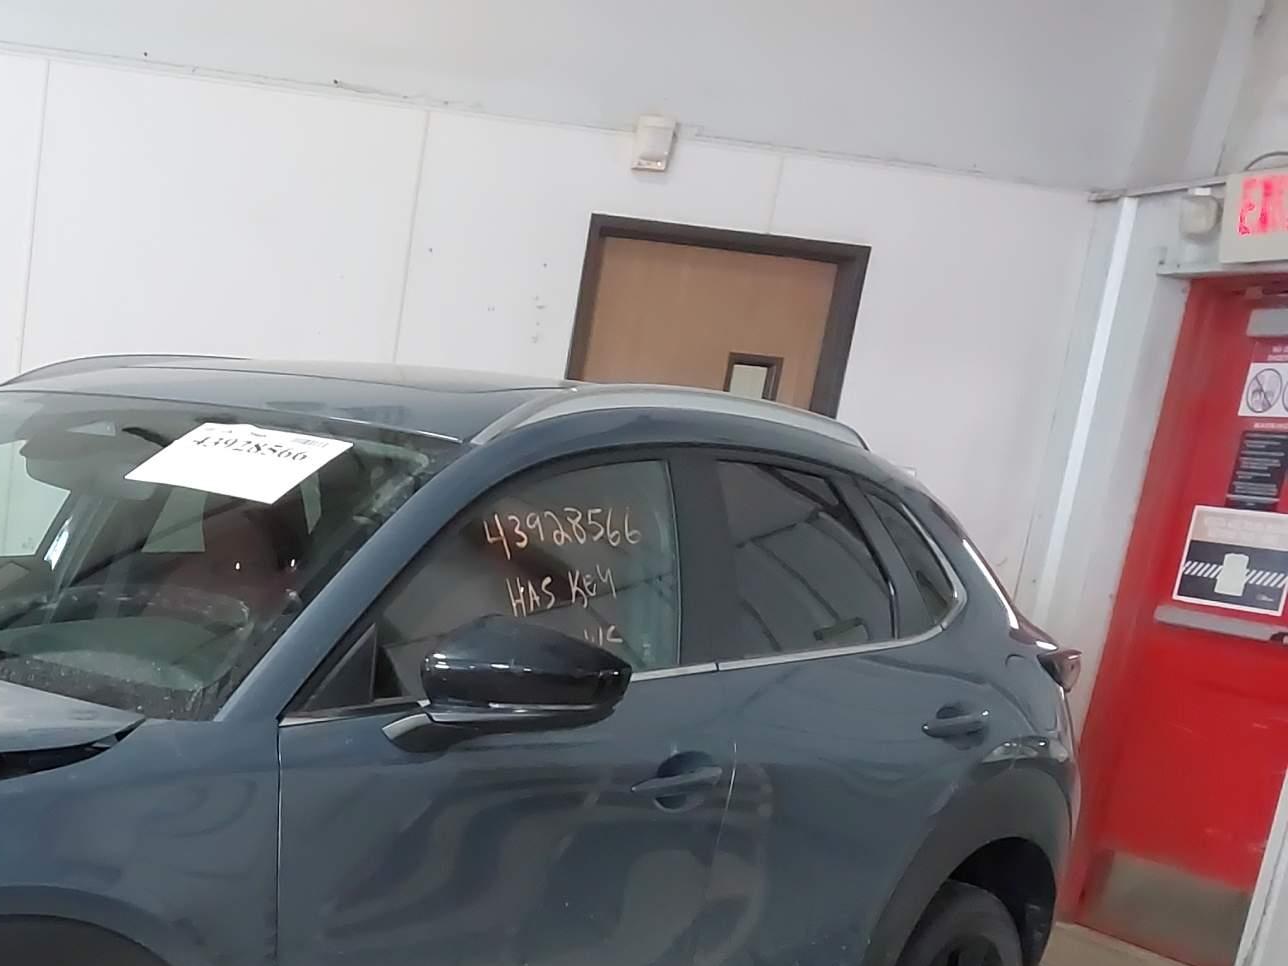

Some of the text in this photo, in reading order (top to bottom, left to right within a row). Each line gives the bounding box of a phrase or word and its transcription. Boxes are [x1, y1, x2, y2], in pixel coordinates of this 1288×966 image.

[193, 436, 308, 461] 43928566
[483, 507, 641, 560] 43928566
[506, 563, 617, 617] HAS KEY
